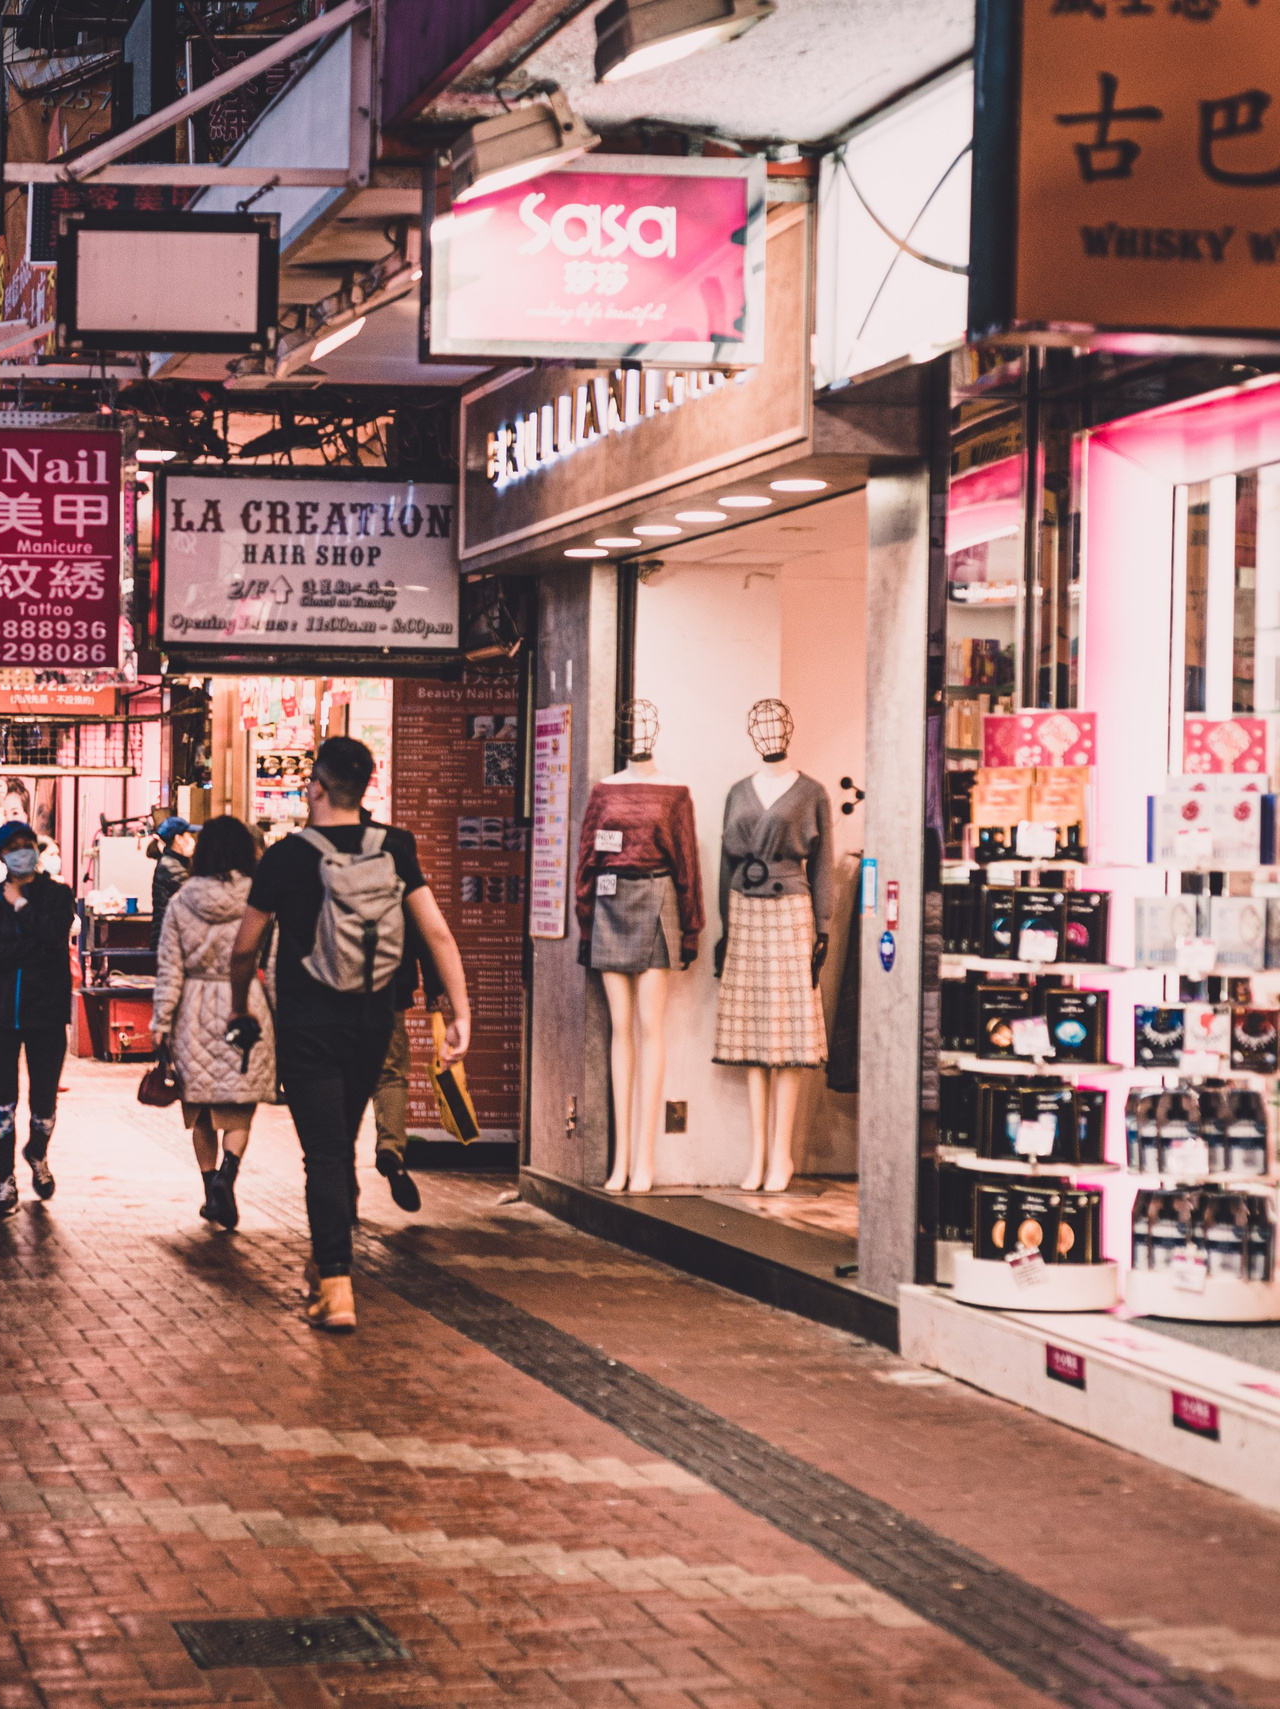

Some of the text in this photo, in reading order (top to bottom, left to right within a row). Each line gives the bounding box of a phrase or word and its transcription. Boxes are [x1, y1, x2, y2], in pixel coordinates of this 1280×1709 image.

[1055, 71, 1280, 189] 古巴
[519, 192, 677, 259] Sasa
[1080, 222, 1237, 266] WHISKY
[1, 447, 110, 485] Nail
[170, 498, 452, 539] LA CREATION
[16, 539, 93, 555] Manicure
[242, 543, 382, 567] HAIR SHOP
[18, 602, 74, 617] Tattoo
[353, 597, 397, 612] Tuesday
[168, 614, 235, 635] Opening
[418, 687, 463, 702] Beauty
[467, 688, 493, 699] Nail
